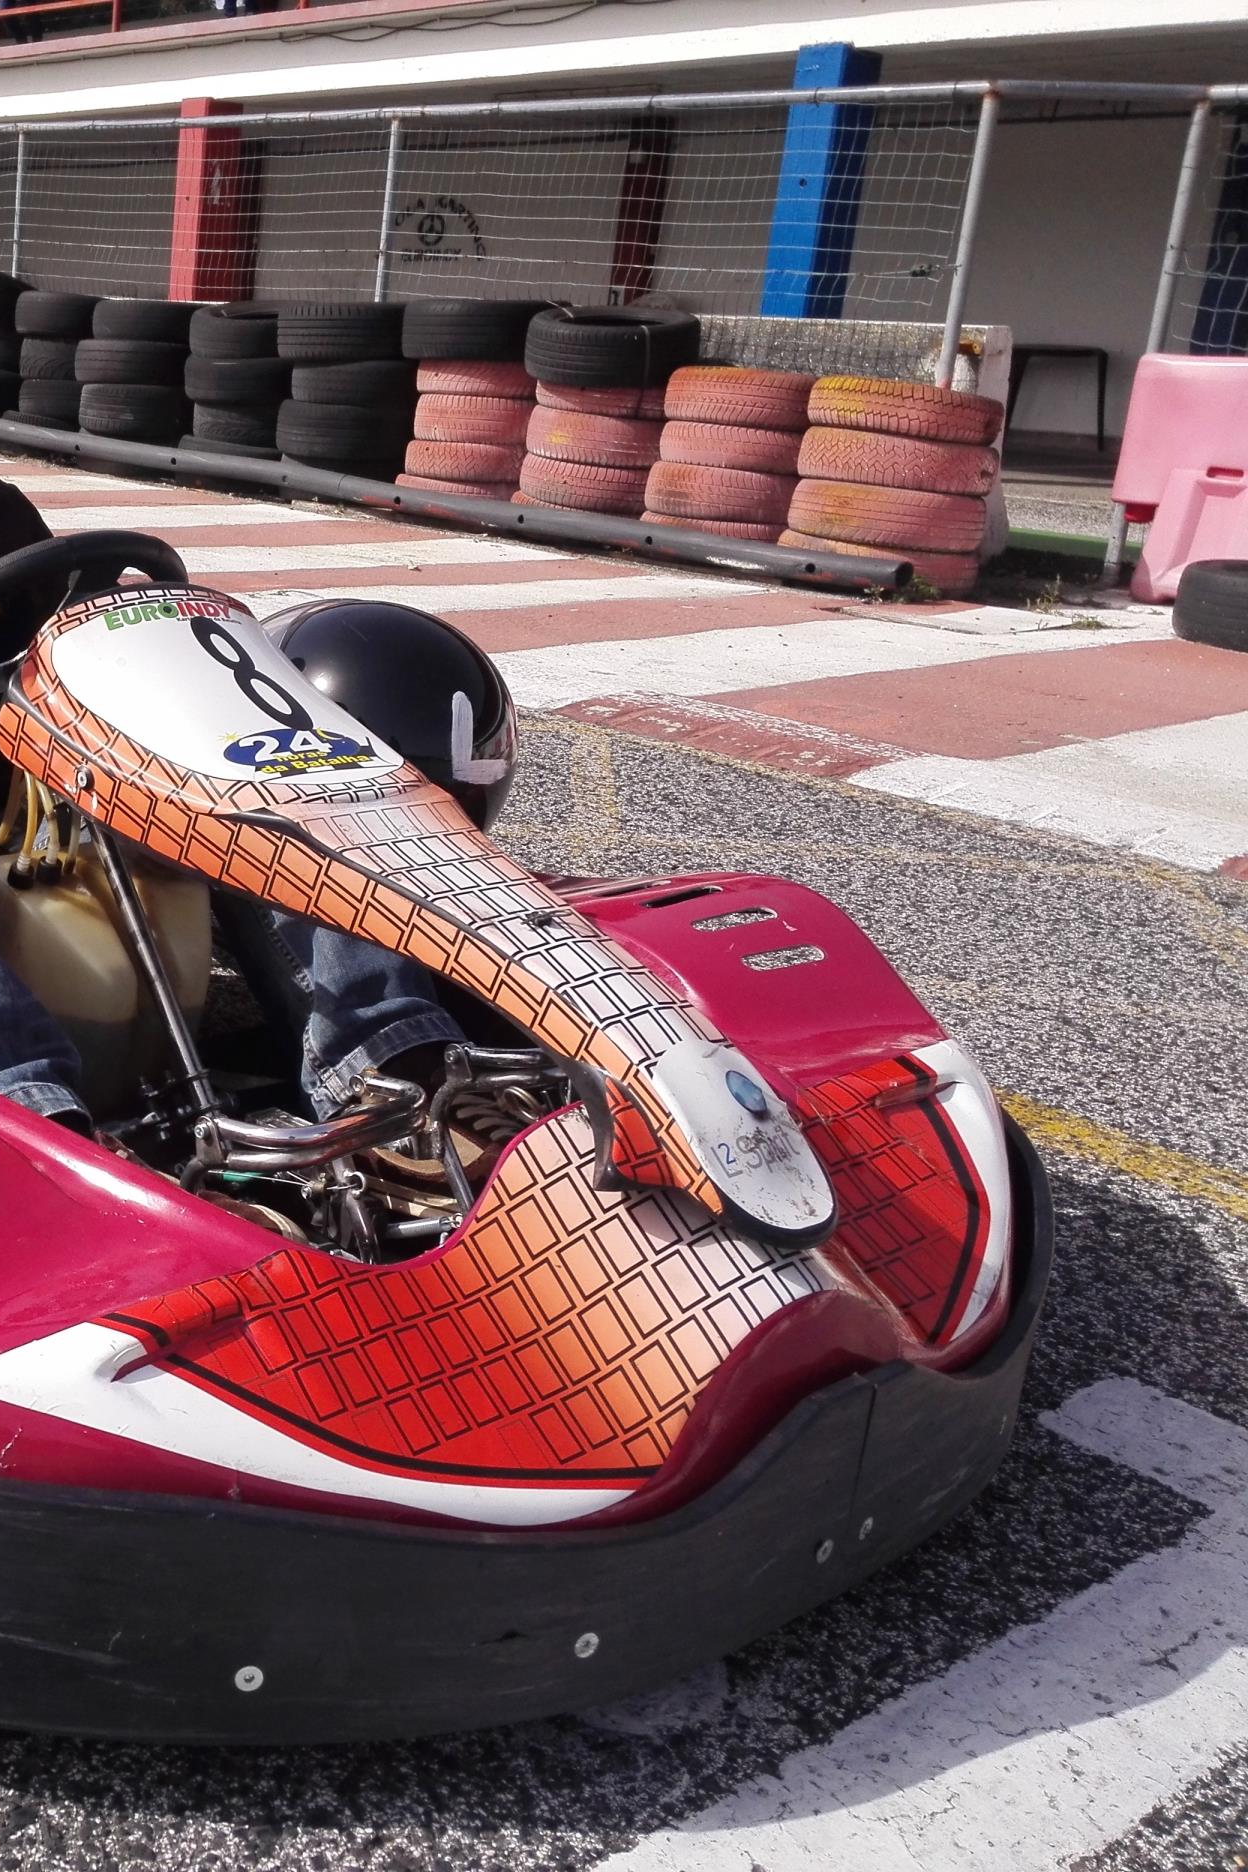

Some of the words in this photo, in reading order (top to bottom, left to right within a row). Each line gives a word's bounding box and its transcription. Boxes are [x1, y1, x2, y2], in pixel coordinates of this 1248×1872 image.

[103, 600, 231, 631] EUROINDY
[190, 616, 313, 731] 8
[238, 730, 332, 763] 24
[260, 765, 289, 774] da
[290, 754, 370, 769] Batalha
